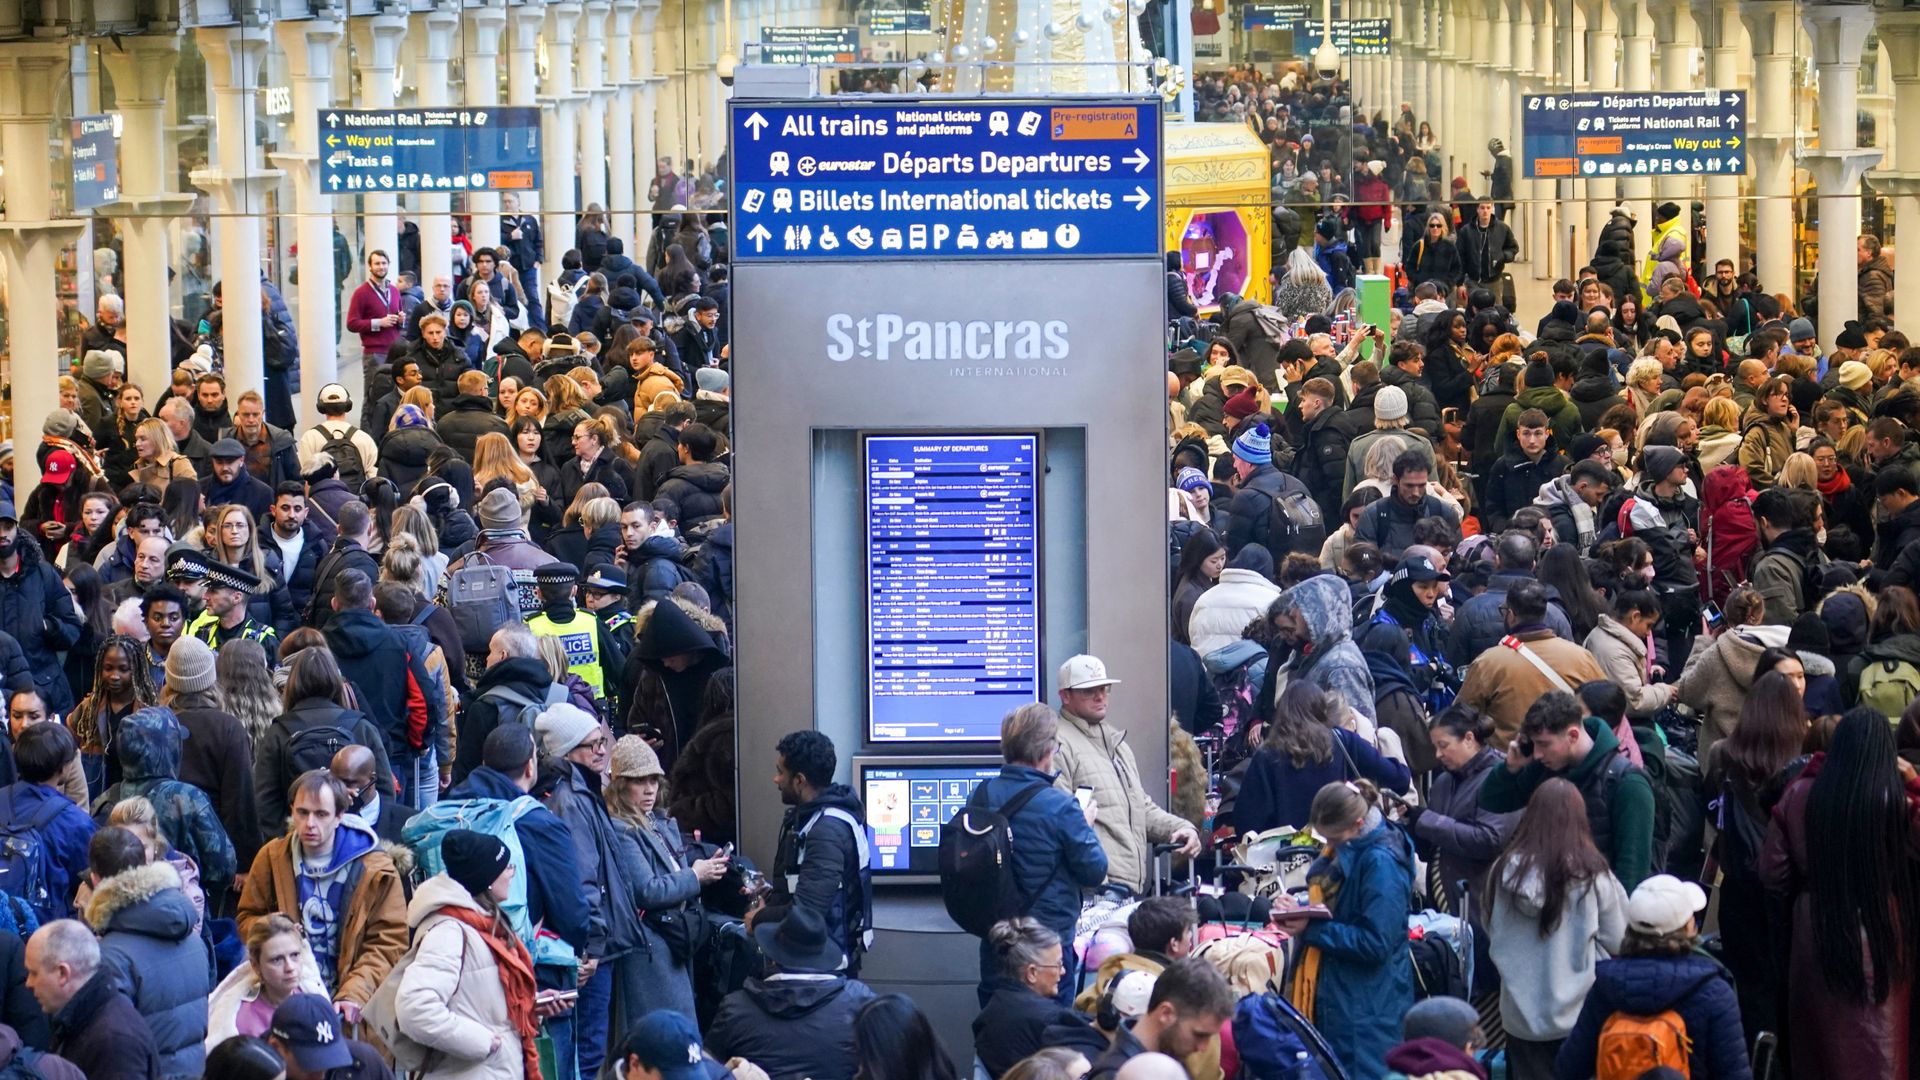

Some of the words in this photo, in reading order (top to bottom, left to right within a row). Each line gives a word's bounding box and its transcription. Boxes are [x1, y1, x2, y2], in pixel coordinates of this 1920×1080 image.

[265, 86, 291, 116] REISS
[1603, 96, 1650, 110] Départs
[1653, 96, 1721, 110] Departures
[345, 113, 395, 126] National
[398, 112, 422, 125] Rail
[896, 111, 941, 122] National
[944, 111, 981, 122] tickets
[1053, 111, 1136, 124] Pre-registration
[1644, 117, 1694, 129] National
[1697, 117, 1721, 128] Rail
[781, 115, 815, 137] All
[821, 115, 888, 136] trains
[896, 123, 917, 136] and
[919, 123, 973, 137] platforms
[1124, 123, 1135, 136] A
[346, 135, 372, 149] Way
[374, 134, 393, 146] out
[1674, 138, 1700, 151] Way
[1702, 138, 1721, 149] out
[346, 156, 379, 168] Taxis
[818, 160, 876, 172] eurostar
[883, 151, 974, 178] Départs
[981, 151, 1112, 178] Departures
[799, 189, 874, 211] Billets
[880, 188, 1030, 211] International
[1035, 187, 1112, 211] tickets
[950, 367, 1070, 376] INTERNATIONAL
[913, 445, 942, 453] SUMMARY
[316, 1020, 334, 1044] NY
[688, 1042, 702, 1063] NY
